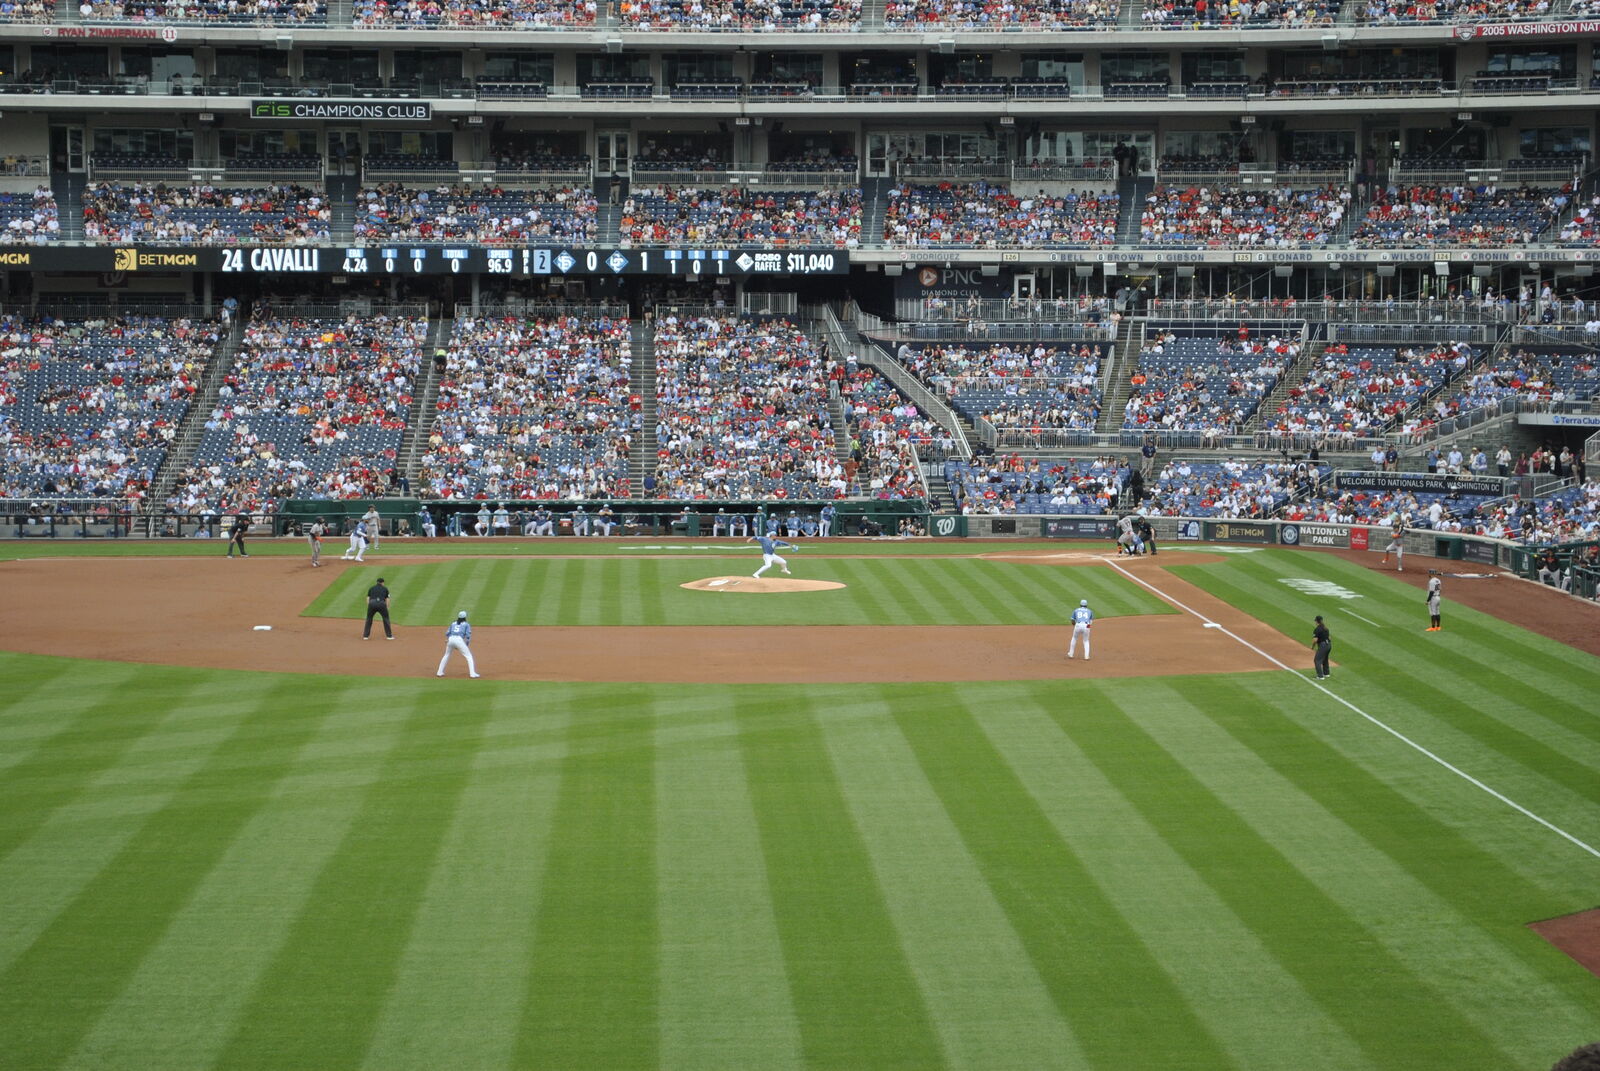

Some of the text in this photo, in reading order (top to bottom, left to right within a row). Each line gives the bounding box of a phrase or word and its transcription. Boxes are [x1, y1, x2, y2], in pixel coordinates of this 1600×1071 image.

[58, 28, 86, 36] RYAN
[88, 28, 156, 38] ZIMMERMAN
[164, 29, 175, 38] 11
[1482, 26, 1505, 36] 2005
[1507, 23, 1578, 34] WASHINGTON
[294, 104, 383, 117] CHAMPIONS
[387, 106, 426, 118] CLUB
[139, 254, 197, 265] BETMGM
[222, 248, 318, 272] 24 CAVALLI
[446, 250, 465, 258] TOTAL
[490, 250, 510, 258] SPEED
[1472, 252, 1510, 260] CRONIN
[1525, 252, 1568, 260] FERRELL
[342, 258, 368, 272] 4.24
[386, 258, 394, 272] 0
[414, 258, 422, 272] 0
[451, 258, 460, 272] 0
[488, 258, 512, 272] 96.9
[539, 254, 546, 270] 2
[586, 252, 598, 271] 0
[640, 252, 648, 272] 1
[670, 260, 676, 274] 1
[692, 260, 700, 274] 0
[718, 260, 722, 274] 1
[754, 262, 781, 272] RAFFLE
[787, 253, 834, 274] $11,040
[942, 269, 982, 285] PNC
[1340, 478, 1376, 486] WELCOME
[1387, 480, 1424, 488] NATIONALS
[1426, 481, 1446, 489] PARK,
[1446, 482, 1490, 491] WASHINGTON
[1490, 484, 1500, 492] DC
[1230, 528, 1264, 537] BETMGM
[1300, 526, 1348, 536] NATIONALS
[1312, 536, 1335, 544] PARK
[1077, 611, 1088, 619] 84
